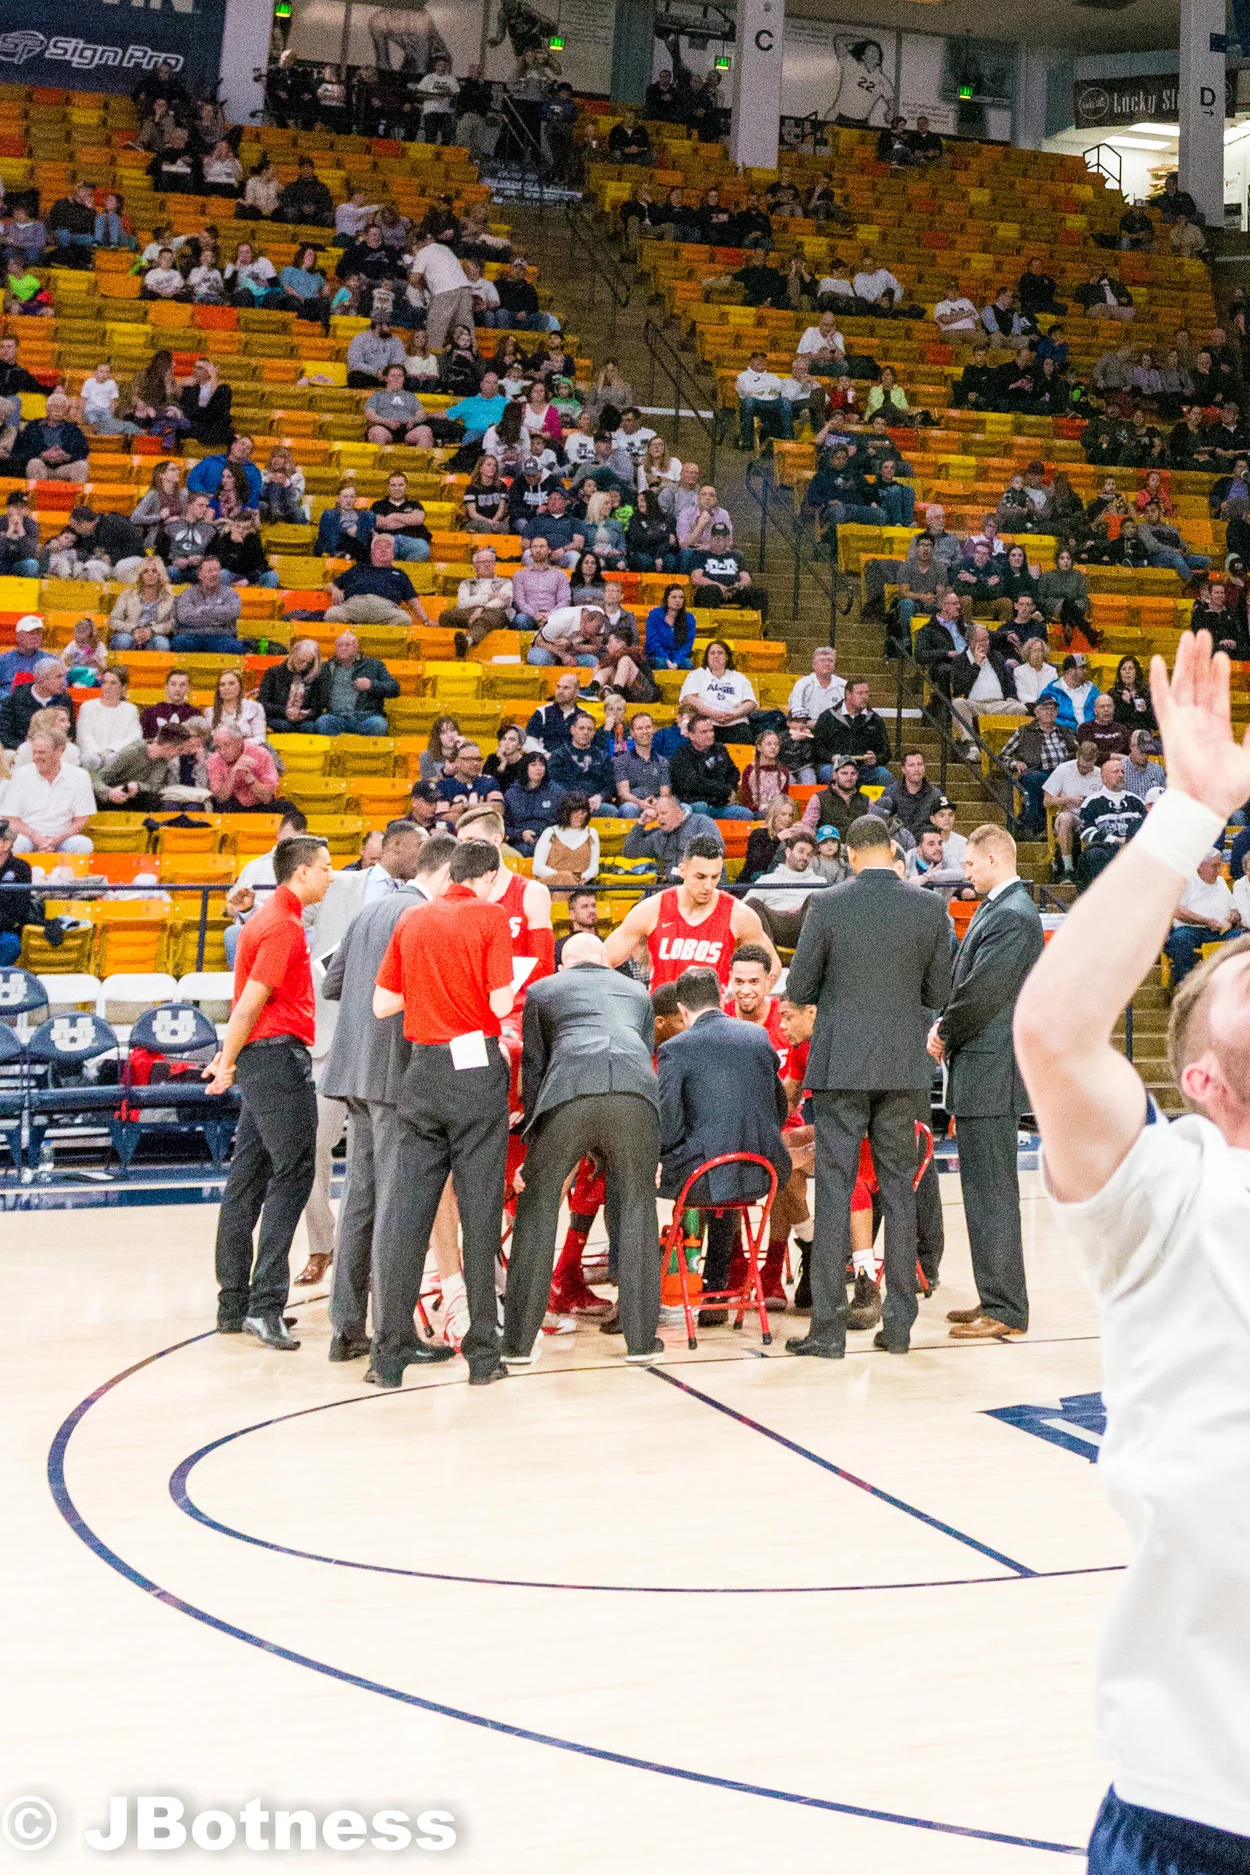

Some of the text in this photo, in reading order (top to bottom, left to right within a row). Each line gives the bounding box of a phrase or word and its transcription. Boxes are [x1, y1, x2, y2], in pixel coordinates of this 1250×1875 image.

[755, 29, 775, 52] C
[45, 36, 185, 72] Sign Pro
[857, 76, 876, 93] 22
[1113, 90, 1156, 114] Lucky
[1200, 86, 1217, 107] D
[658, 937, 723, 964] LOBOS
